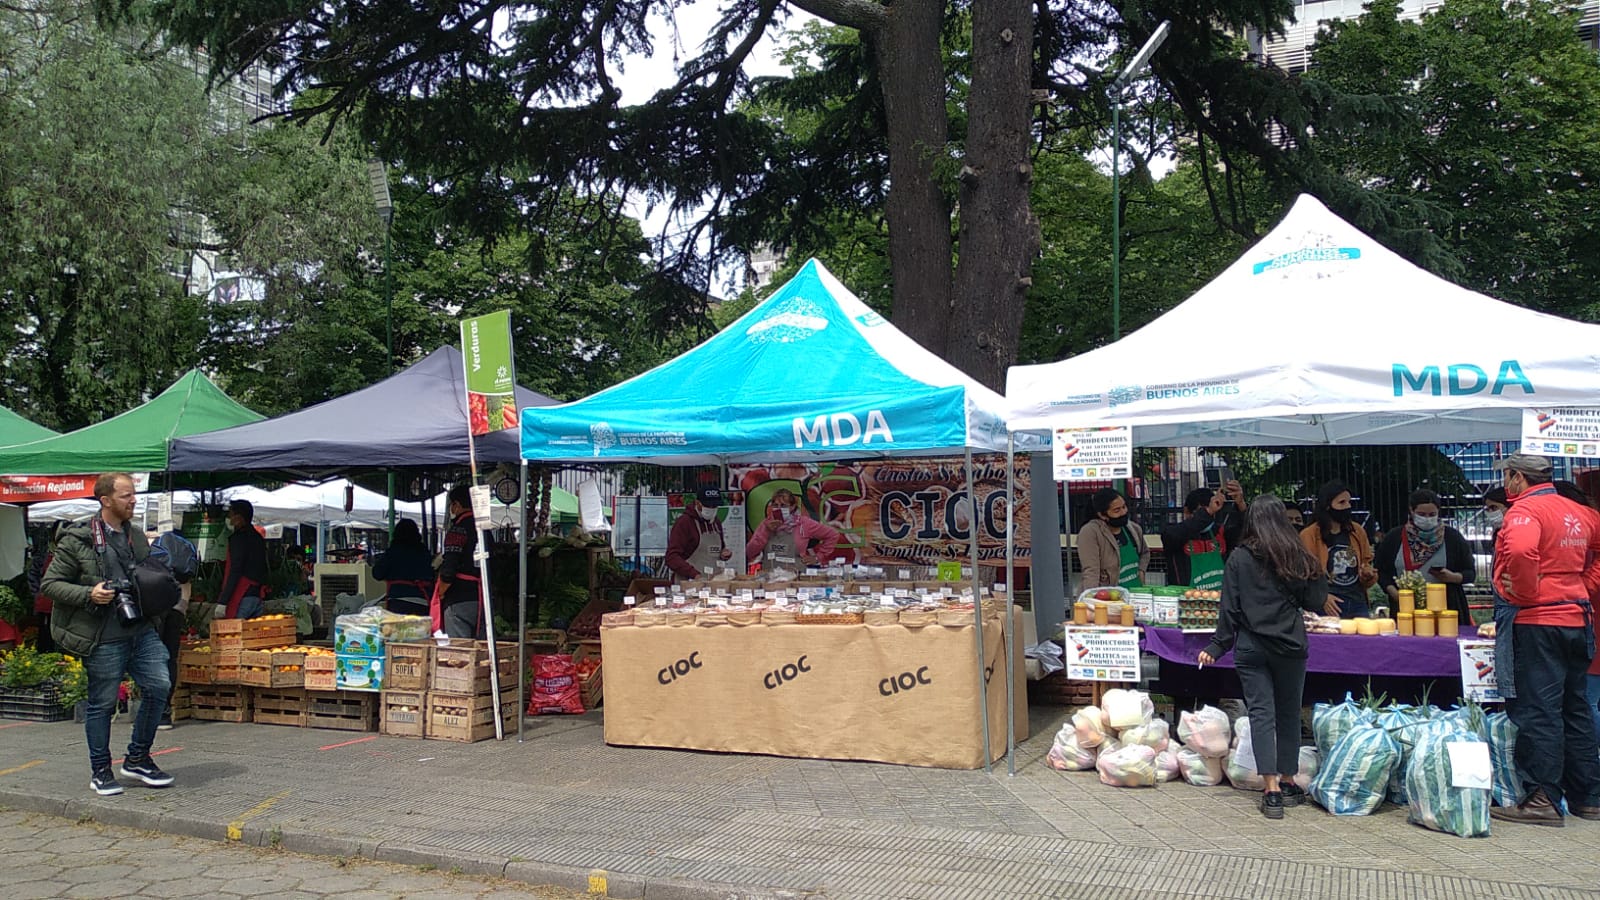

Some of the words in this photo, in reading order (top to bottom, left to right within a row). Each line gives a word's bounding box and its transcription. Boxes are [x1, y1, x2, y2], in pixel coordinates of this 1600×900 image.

[470, 320, 481, 373] Verduras
[1146, 388, 1199, 400] BUENOS
[1203, 385, 1240, 396] AIRES
[1392, 360, 1536, 397] MDA
[620, 437, 658, 446] BUENOS
[660, 437, 688, 446] AIRES
[792, 409, 894, 448] MDA
[47, 480, 84, 495] Regional
[880, 490, 1018, 540] CIOC
[874, 543, 940, 558] Semillas
[395, 664, 414, 675] SOFIA
[657, 651, 703, 685] CIOC
[763, 655, 811, 690] CIOC
[878, 666, 932, 696] CIOC
